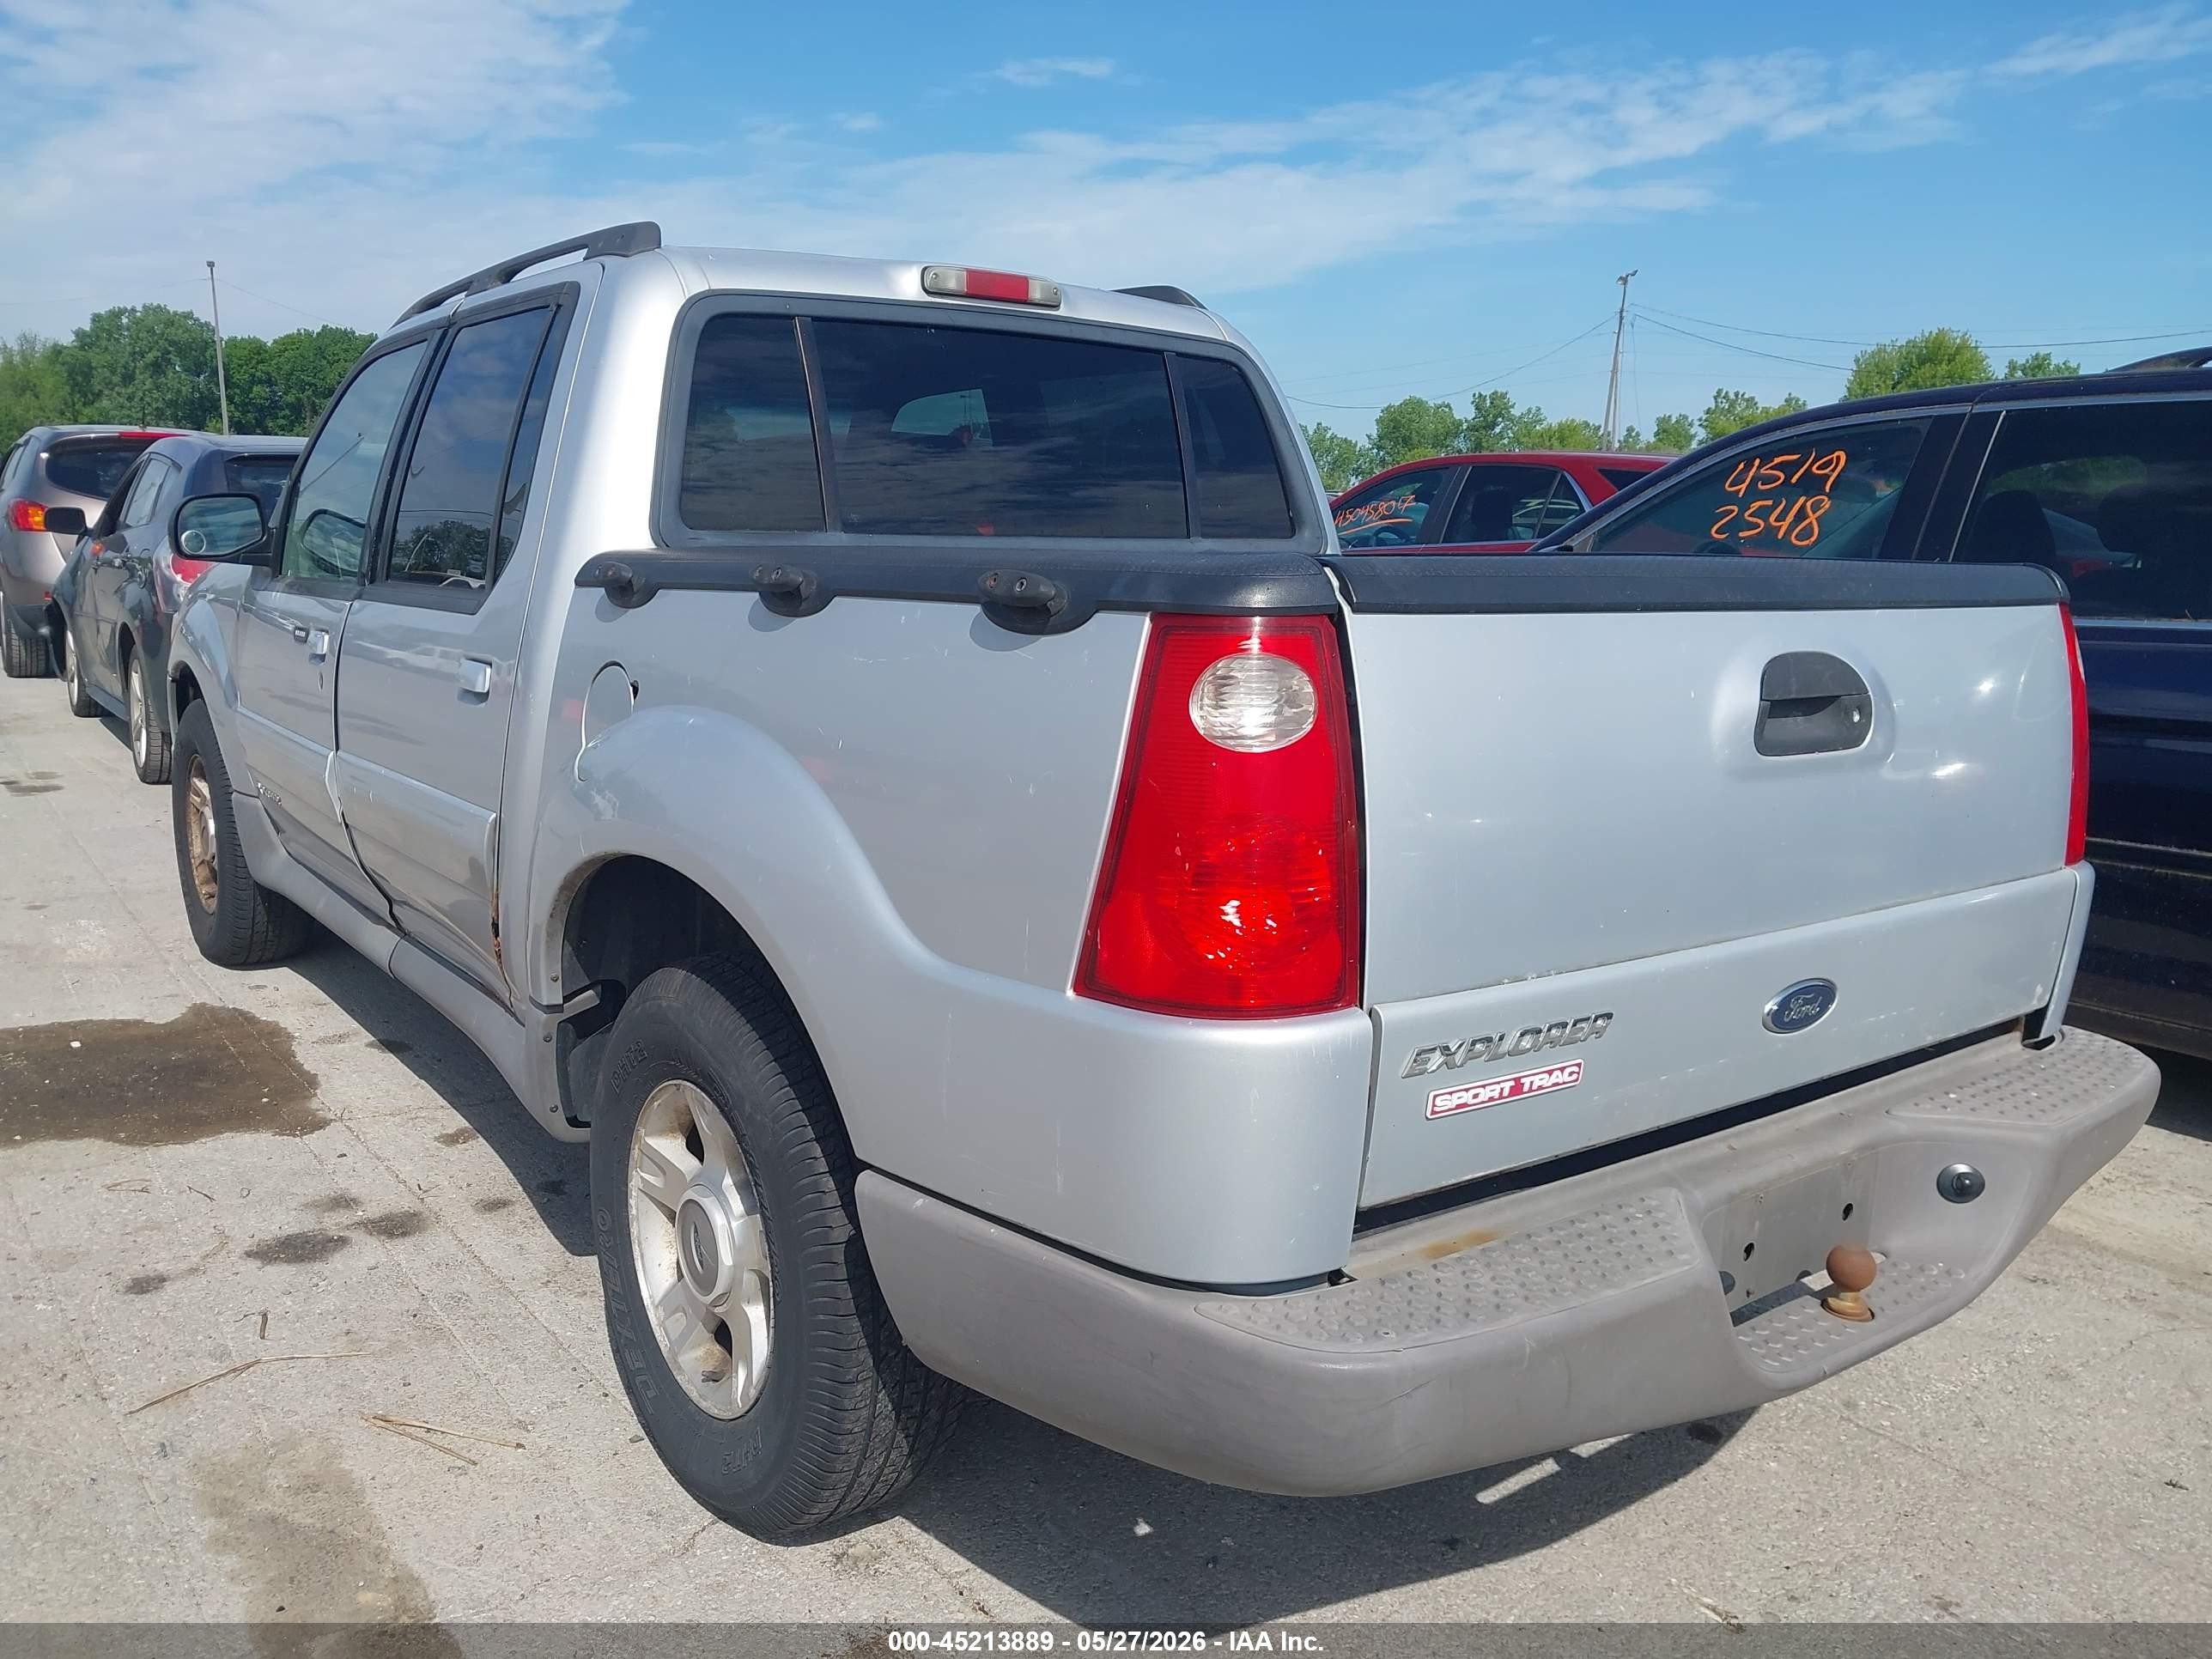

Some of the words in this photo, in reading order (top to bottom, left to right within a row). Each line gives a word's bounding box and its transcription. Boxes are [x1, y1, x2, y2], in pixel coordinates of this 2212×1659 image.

[1724, 448, 1846, 497] 4519
[1711, 495, 1831, 546] 2548
[1401, 1012, 1613, 1079] EXPLORER
[1432, 1079, 1517, 1113] SPORT
[1520, 1065, 1580, 1093] TRAC
